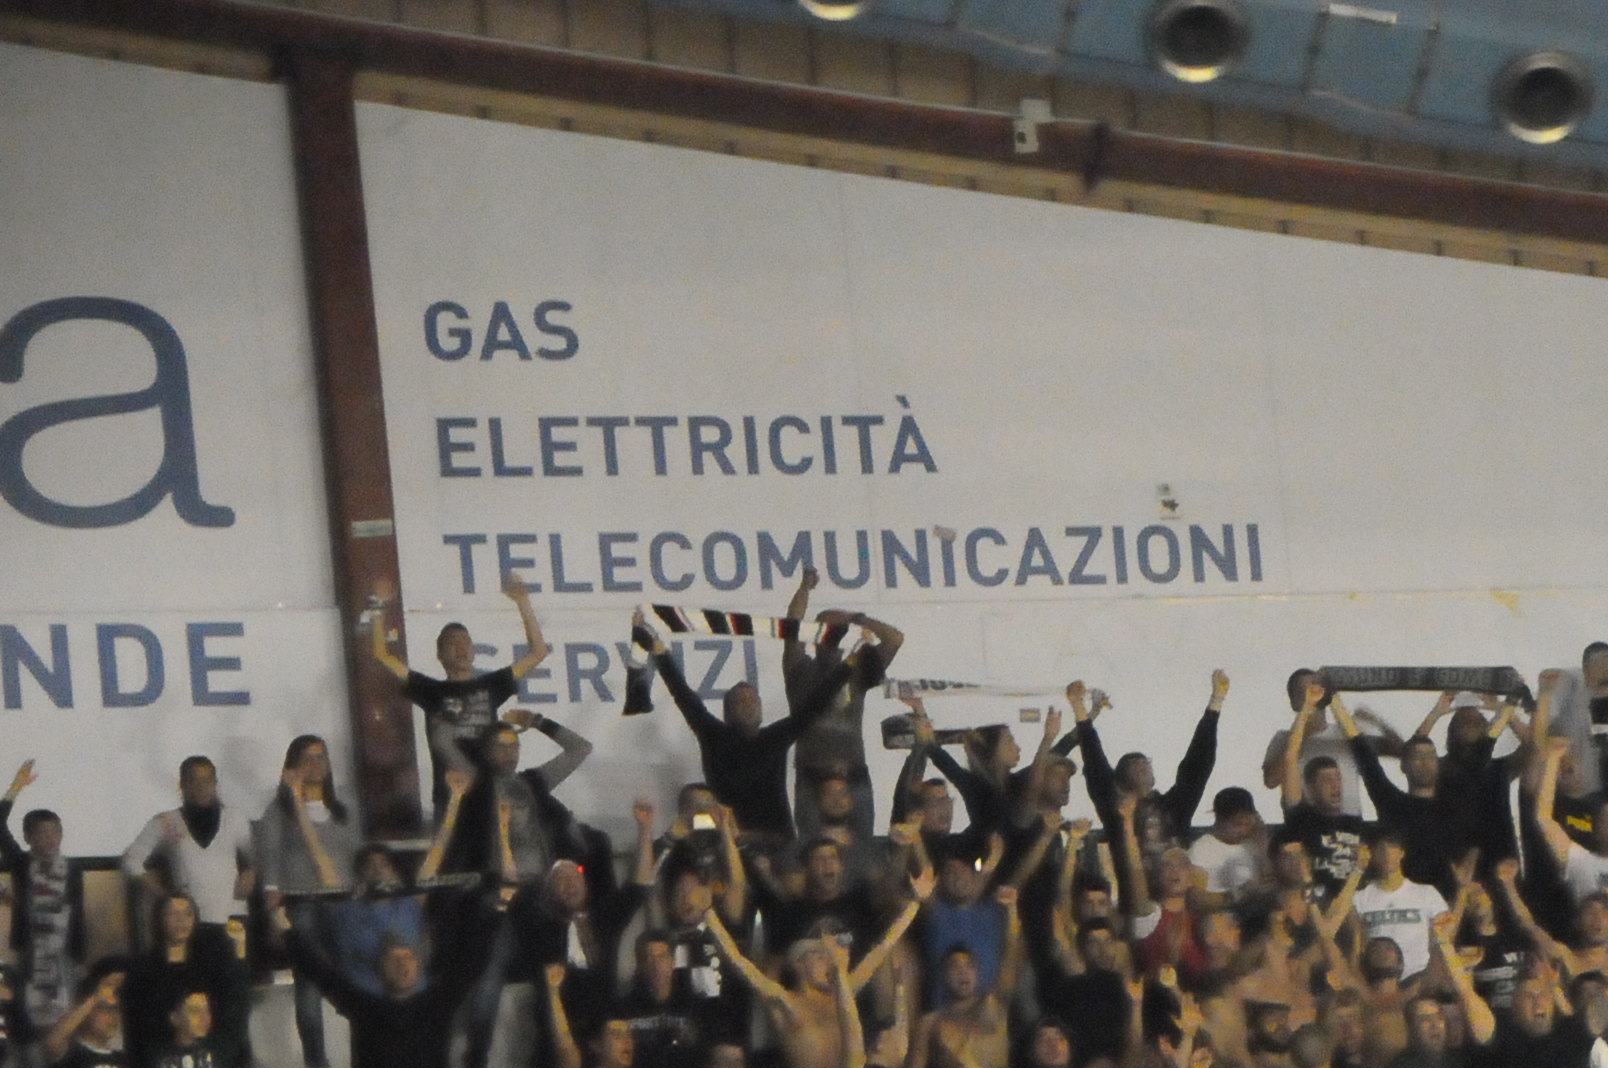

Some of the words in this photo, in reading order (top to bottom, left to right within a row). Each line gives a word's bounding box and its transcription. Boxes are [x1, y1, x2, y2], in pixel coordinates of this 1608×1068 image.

[424, 301, 579, 361] GAS
[436, 395, 937, 477] ELETTRICITÀ
[443, 523, 1263, 595] TELECOMUNICAZIONI
